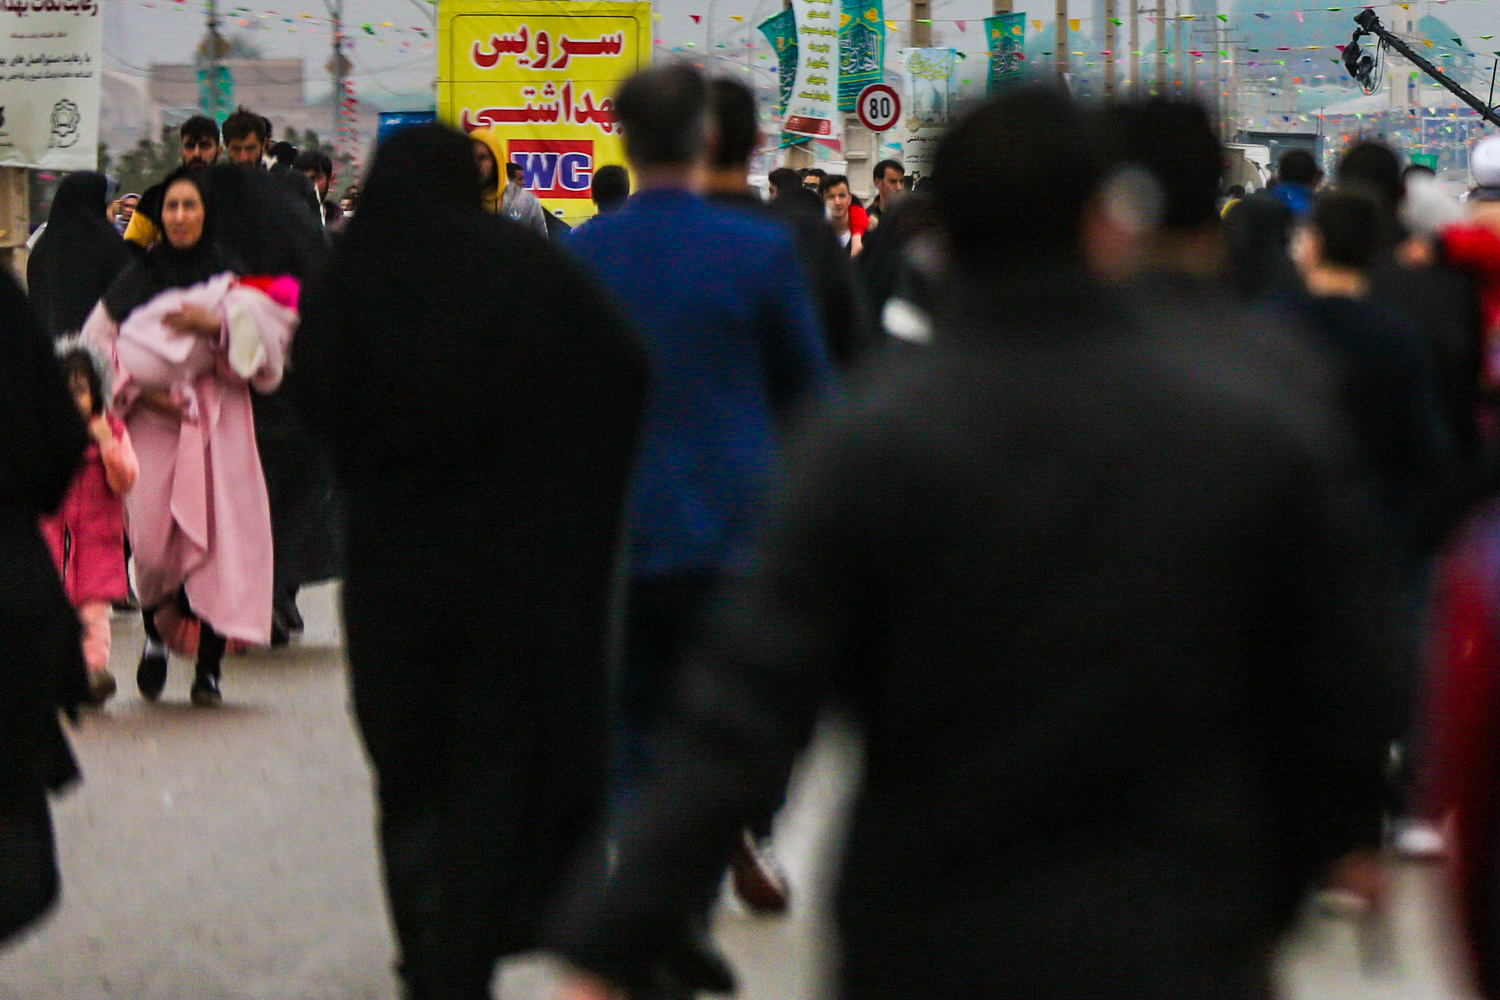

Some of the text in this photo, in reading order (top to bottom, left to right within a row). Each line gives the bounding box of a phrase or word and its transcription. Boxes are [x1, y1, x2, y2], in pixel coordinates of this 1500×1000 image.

[473, 25, 623, 69] سرویس
[869, 97, 890, 119] 80
[511, 152, 592, 190] WC
